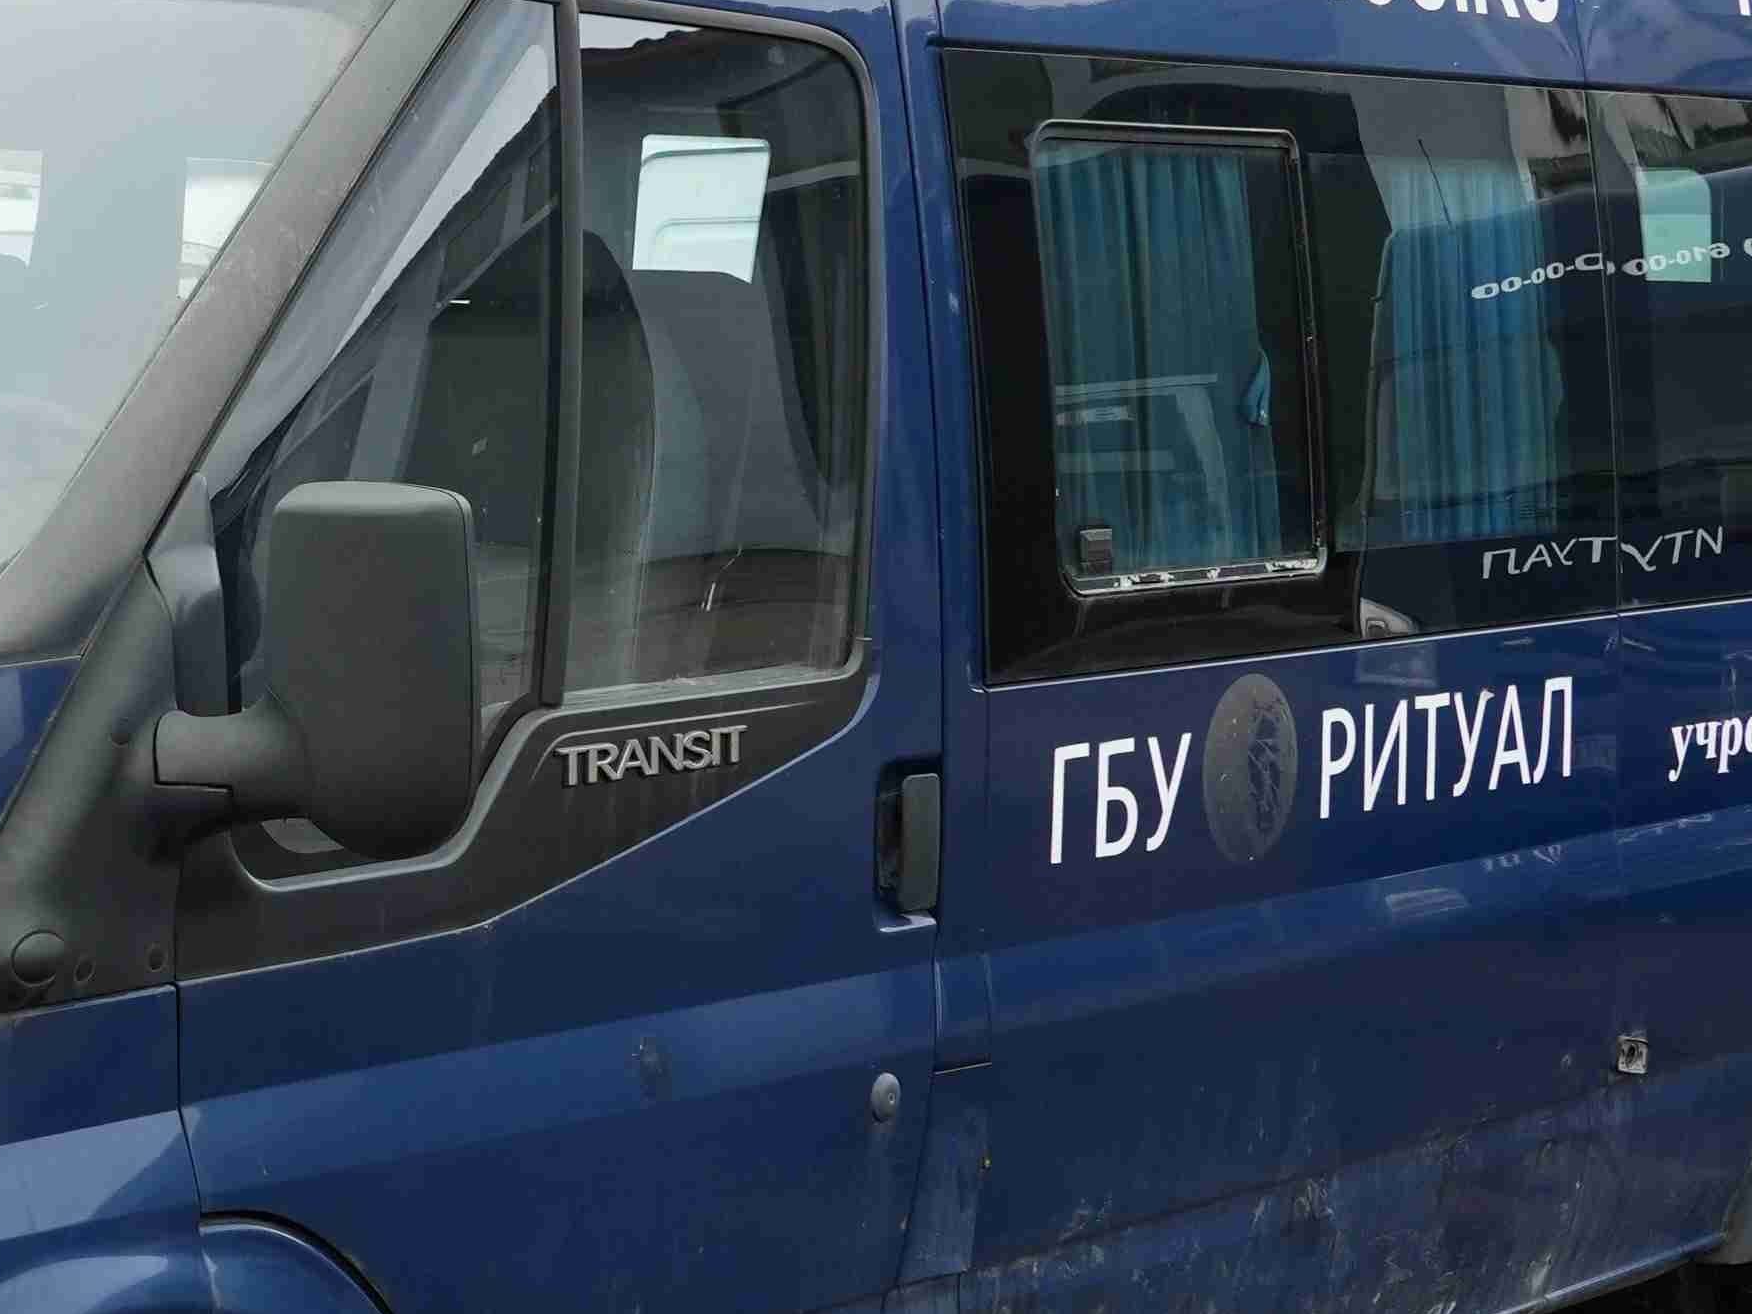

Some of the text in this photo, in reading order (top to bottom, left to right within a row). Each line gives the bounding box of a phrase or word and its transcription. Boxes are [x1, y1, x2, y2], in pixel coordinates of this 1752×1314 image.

[556, 725, 748, 786] TRANSIT
[1050, 675, 1573, 865] ГБУ РИТУАЛ
